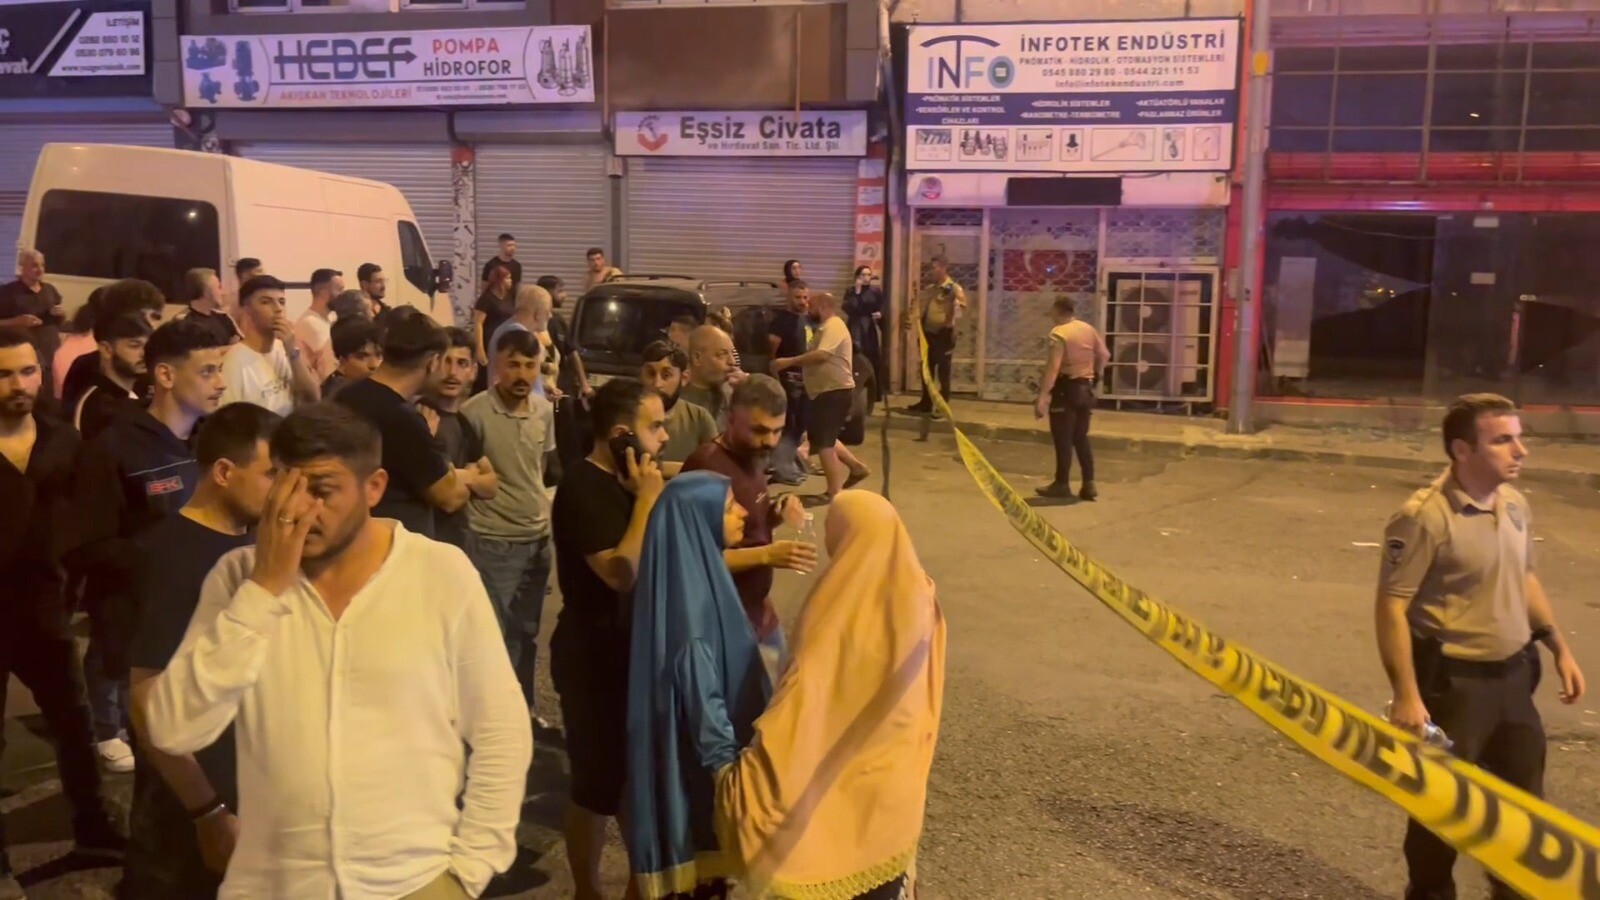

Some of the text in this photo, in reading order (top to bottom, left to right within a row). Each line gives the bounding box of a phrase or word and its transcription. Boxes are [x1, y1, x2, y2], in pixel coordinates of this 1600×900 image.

[432, 38, 500, 54] POMPA
[1020, 30, 1225, 52] İNFOTEK ENDÜSTRİ
[423, 57, 512, 76] HİDROFOR
[1117, 55, 1170, 64] OTOMASYON
[1173, 53, 1225, 62] SİSTEMLERİ
[1042, 68, 1066, 77] 0545
[1124, 67, 1148, 76] 0544
[1151, 67, 1169, 75] 221
[1173, 67, 1184, 75] 11
[330, 87, 412, 100] TEKNOLOJİLERİ
[679, 115, 841, 145] Eşsiz Civata
